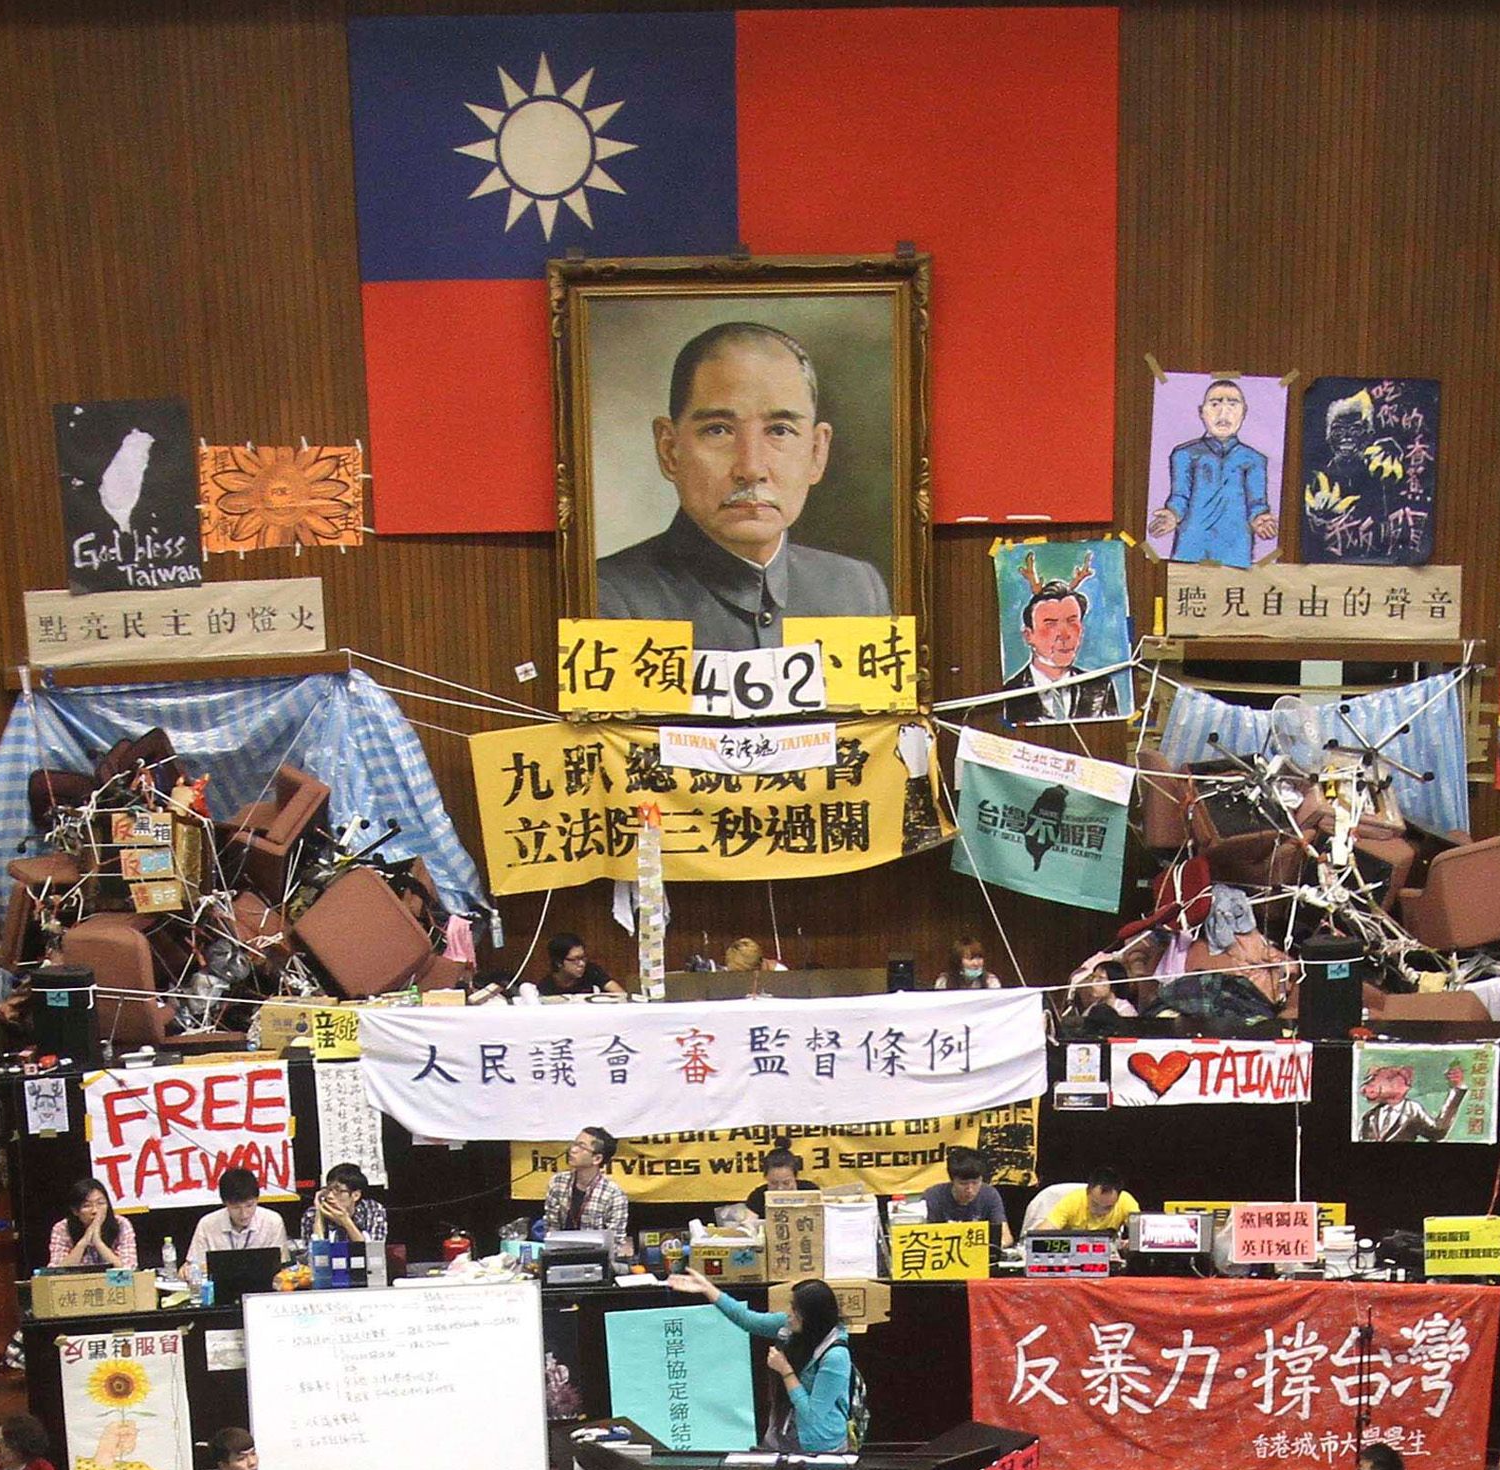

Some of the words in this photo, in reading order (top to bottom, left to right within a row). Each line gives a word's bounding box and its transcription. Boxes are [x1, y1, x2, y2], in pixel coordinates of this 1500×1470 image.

[73, 526, 121, 569] God
[134, 526, 187, 561] bless
[118, 564, 203, 588] Taiwan
[1175, 585, 1453, 620] 聽見自由的聲音
[37, 603, 317, 644] 點亮民主的燈火
[666, 731, 718, 750] TAIWAN
[781, 732, 832, 753] TAIWAN
[507, 800, 870, 867] 立法院三秒過關
[1190, 1046, 1313, 1100] TAIWAN
[100, 1067, 290, 1147] FREE
[94, 1135, 292, 1198] TAIWAN
[531, 1150, 558, 1173] in
[812, 1146, 830, 1170] 3
[899, 1228, 989, 1279] 資訊組
[1045, 1240, 1071, 1253] 792
[62, 1333, 181, 1365] 反黑箱服貿
